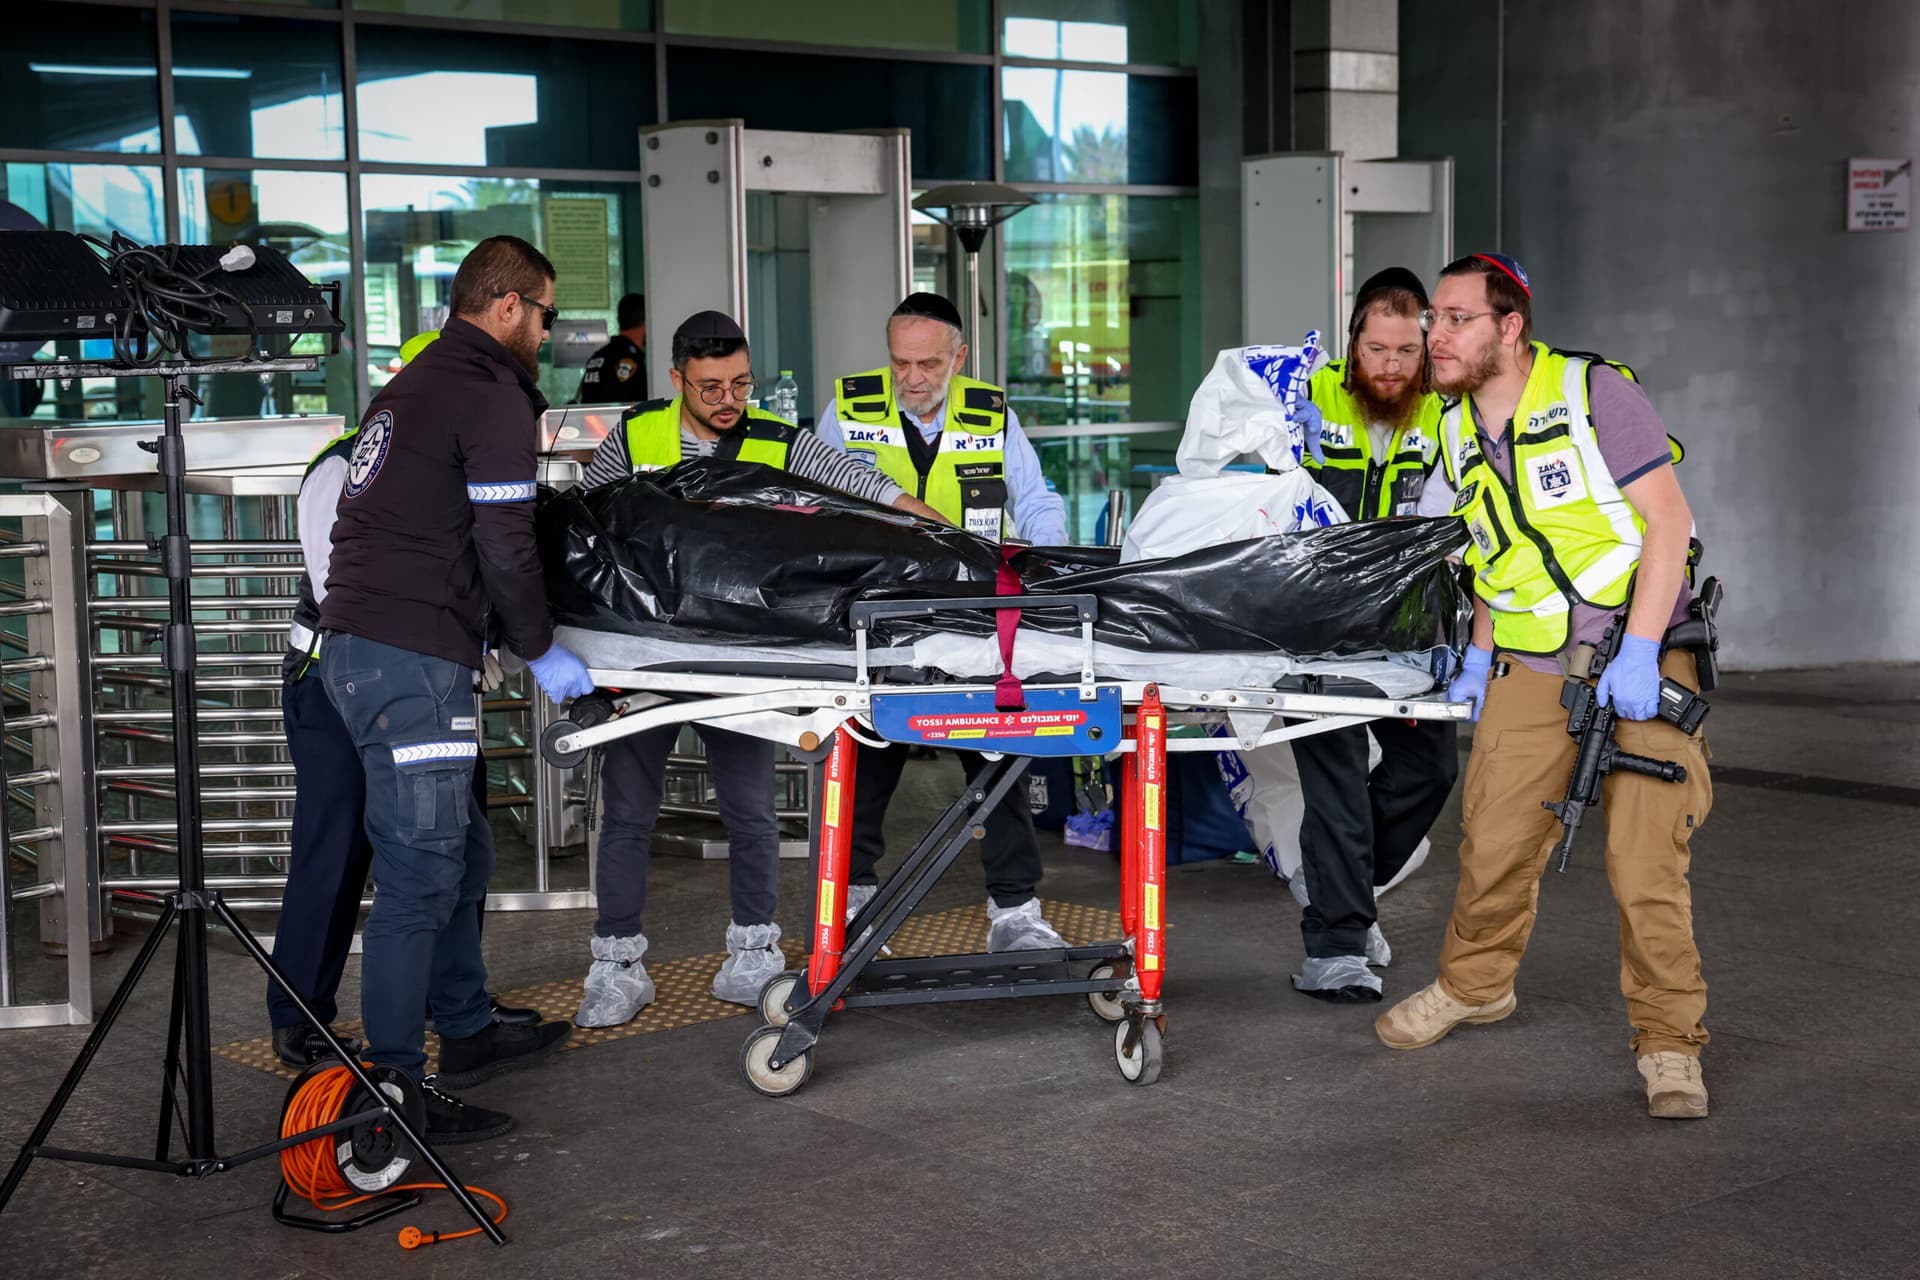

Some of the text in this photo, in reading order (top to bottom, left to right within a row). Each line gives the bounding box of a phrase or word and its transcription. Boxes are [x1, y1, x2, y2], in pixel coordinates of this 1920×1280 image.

[1529, 407, 1568, 427] משרה
[916, 716, 1000, 727] YOSSI AMBULANCE
[1020, 713, 1080, 724] יוסי אמבולנס
[1147, 732, 1156, 747] יוסי
[1147, 748, 1156, 780] אמבולנס
